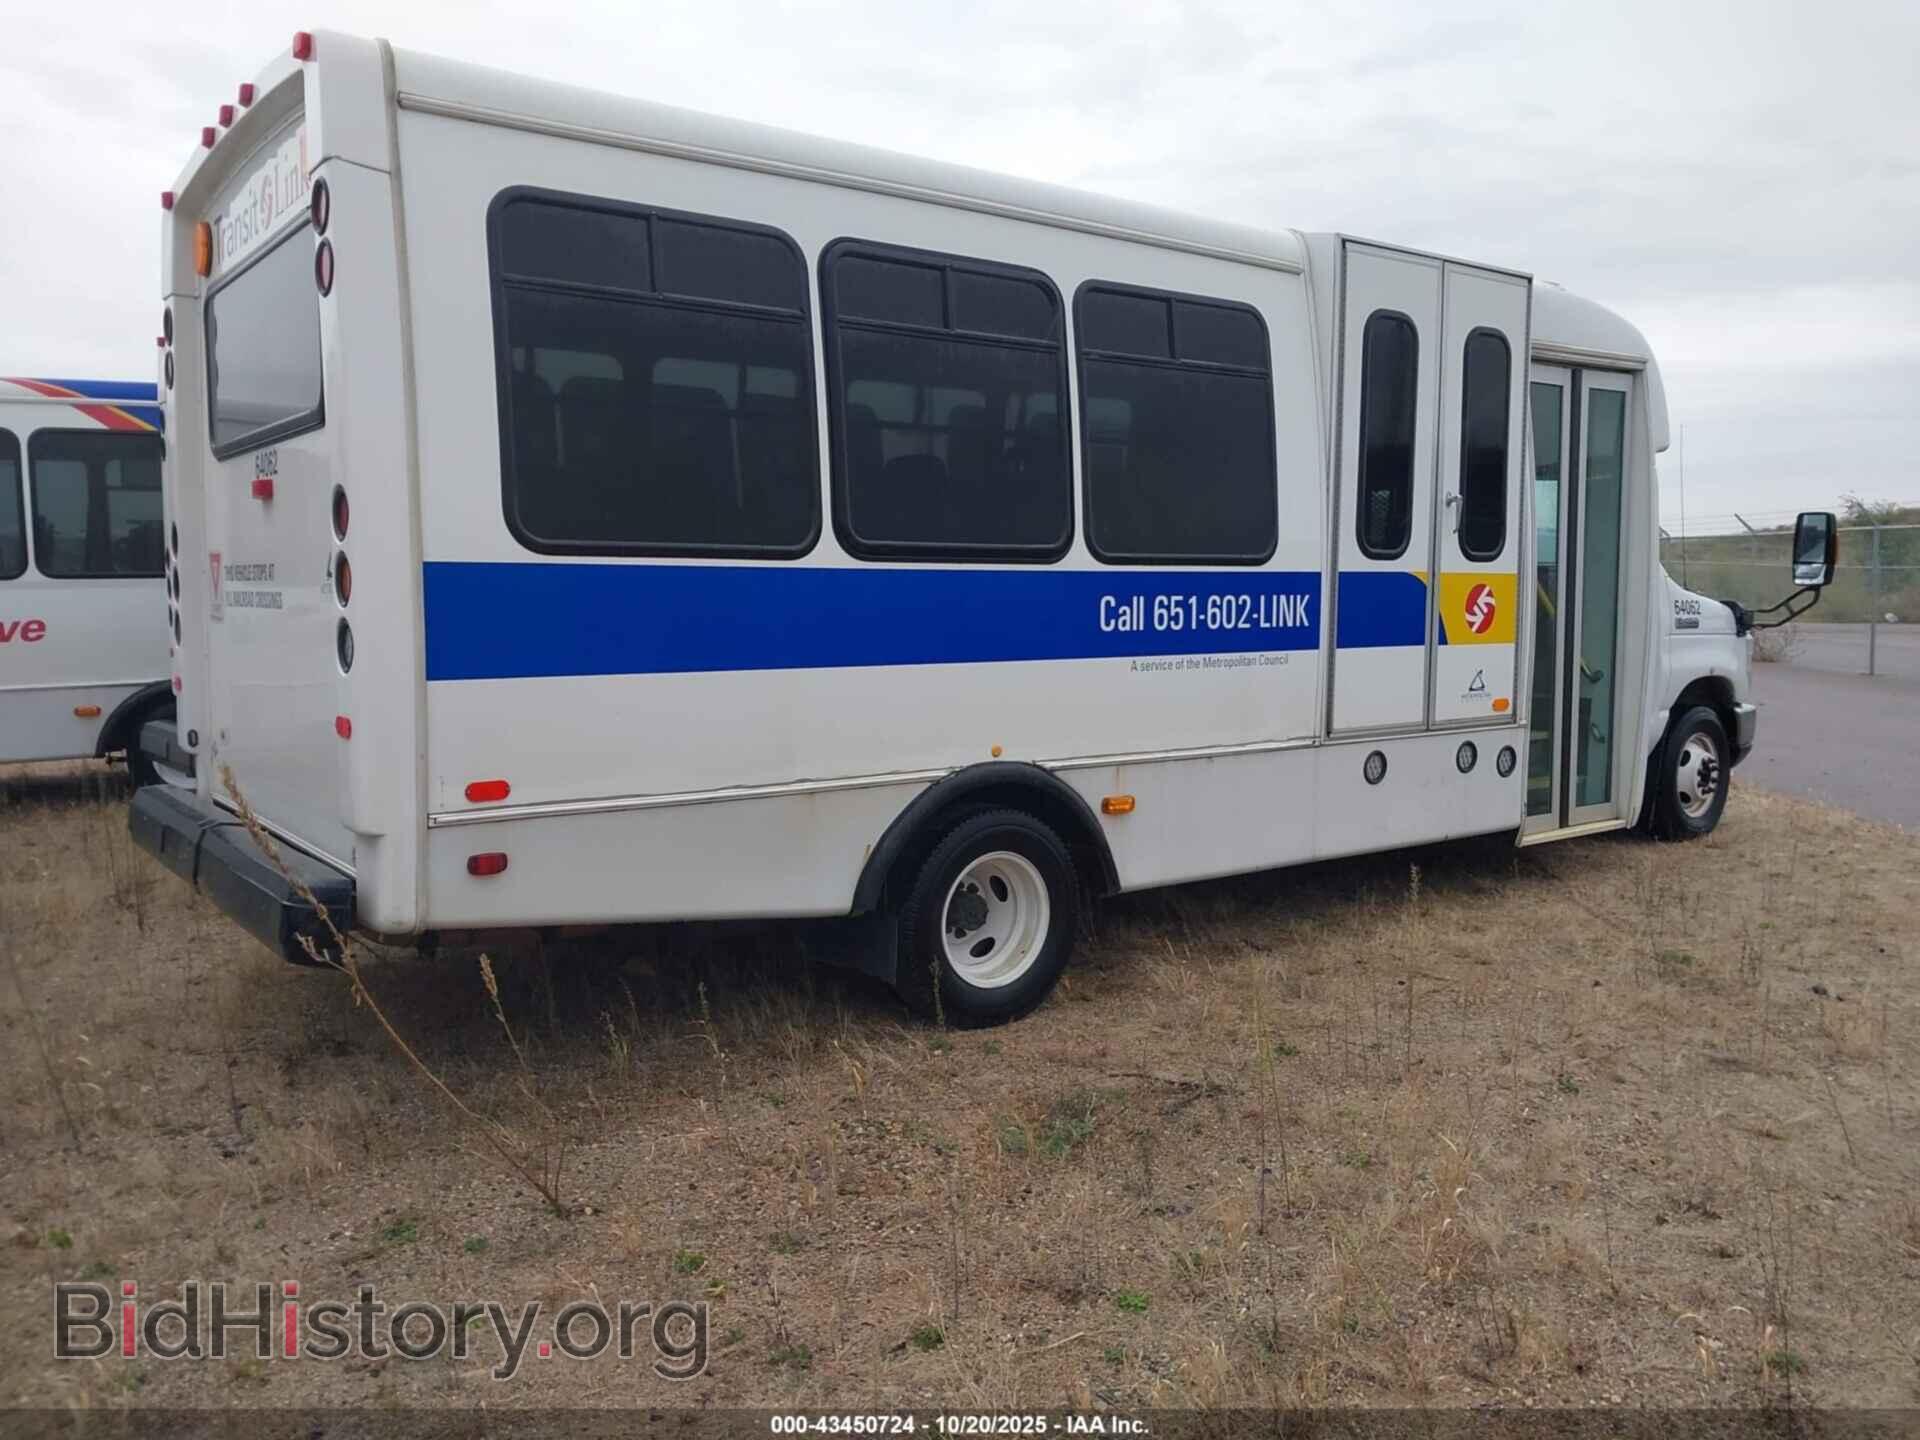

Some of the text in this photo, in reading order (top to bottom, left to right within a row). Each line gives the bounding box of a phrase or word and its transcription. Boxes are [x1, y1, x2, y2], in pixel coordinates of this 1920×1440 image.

[214, 187, 259, 265] Transit
[1100, 594, 1310, 632] Call 651-602-LINK
[1130, 654, 1289, 672] A service of the Metropolitan Council
